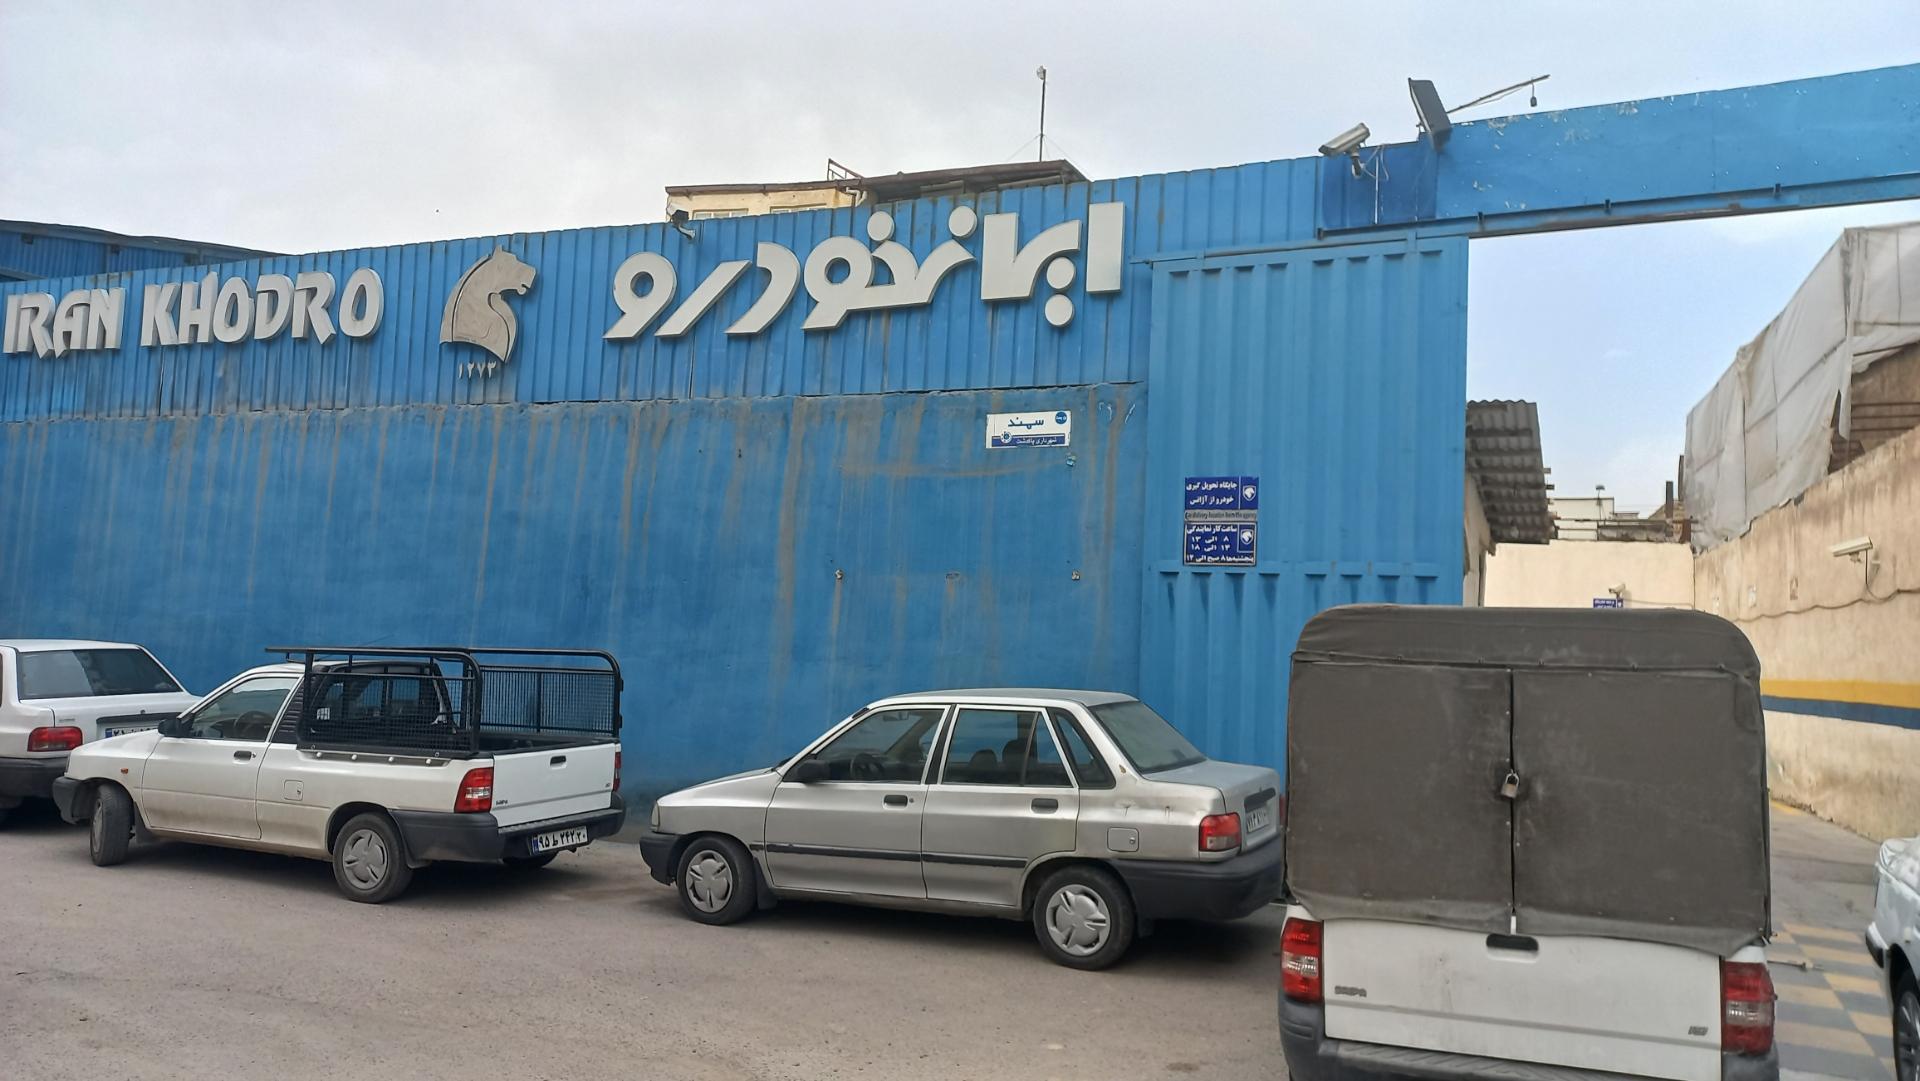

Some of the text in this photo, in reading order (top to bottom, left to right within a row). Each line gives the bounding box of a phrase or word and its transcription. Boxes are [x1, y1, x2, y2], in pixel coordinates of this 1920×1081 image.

[3, 267, 384, 358] IRAN KHODRO
[1007, 416, 1045, 430] سهند
[1201, 481, 1219, 491] تحویل
[1220, 481, 1237, 490] جایگاه
[1216, 495, 1234, 505] خودرو
[1204, 536, 1218, 544] الی
